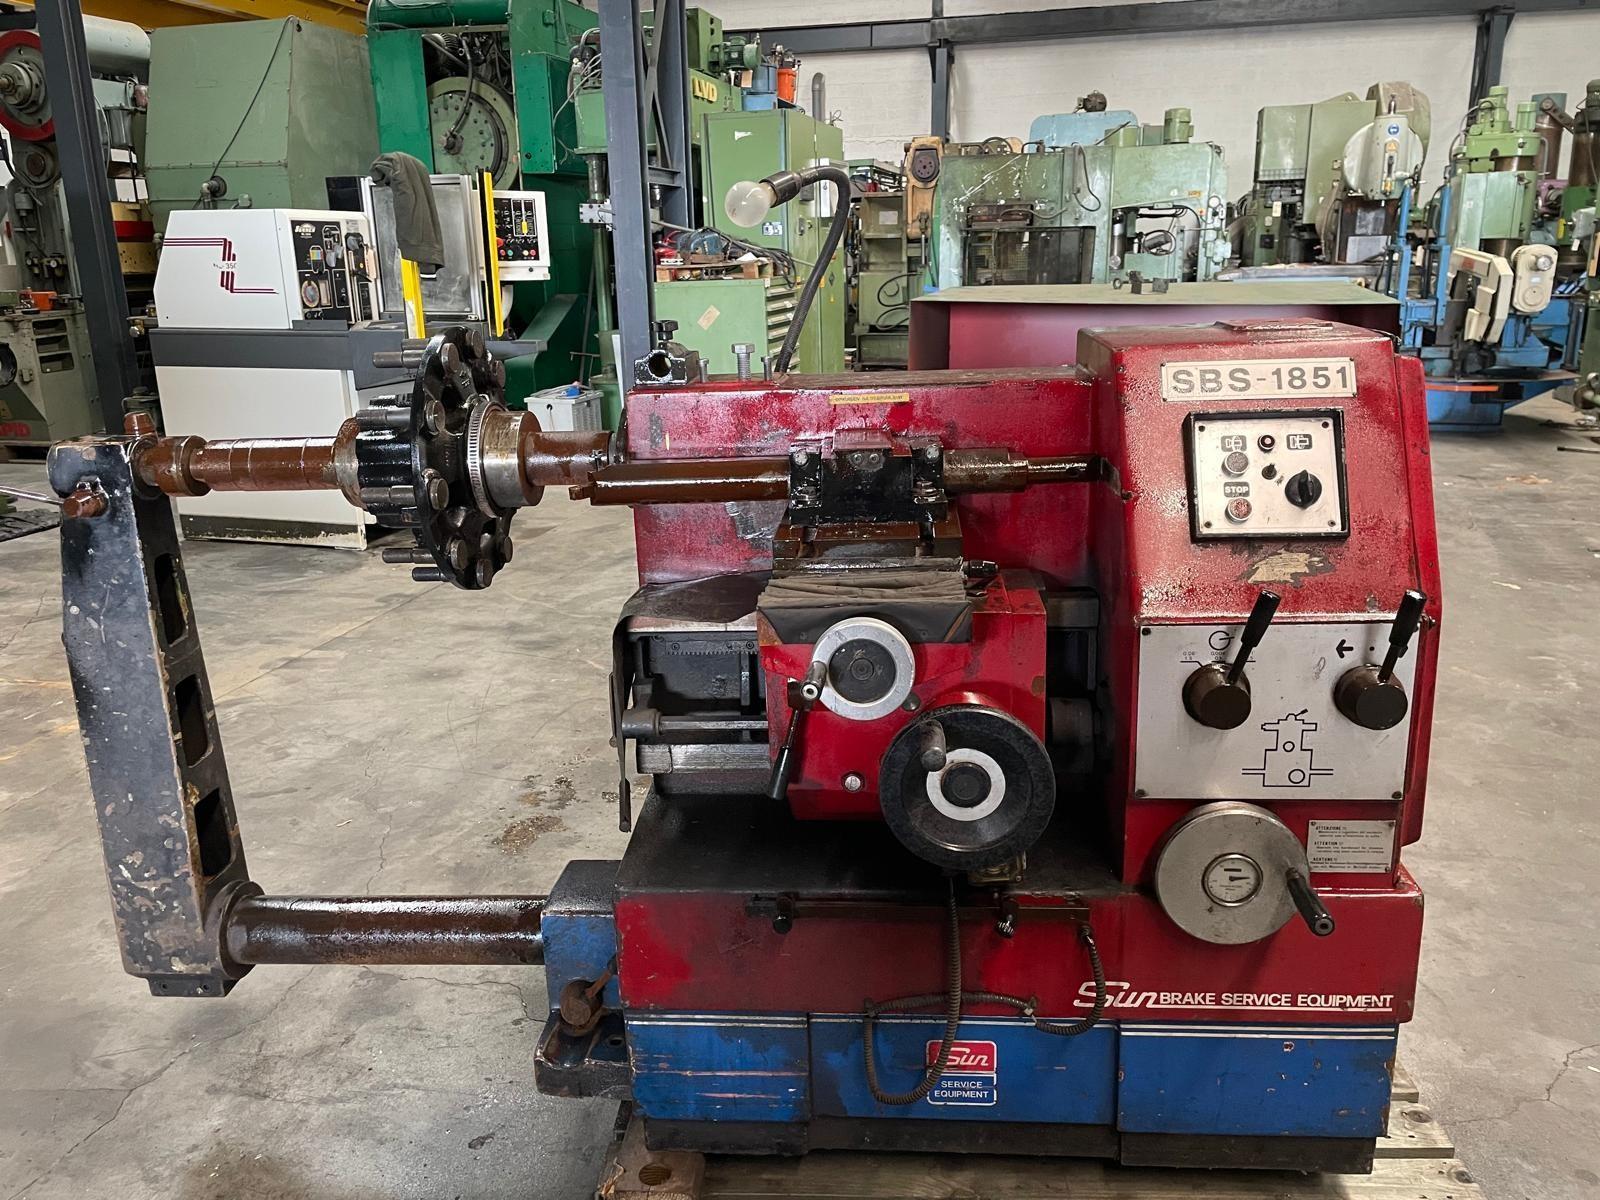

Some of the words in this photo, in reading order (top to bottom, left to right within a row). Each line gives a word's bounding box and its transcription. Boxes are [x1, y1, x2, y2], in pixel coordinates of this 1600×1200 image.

[694, 79, 718, 101] LVD
[1172, 366, 1348, 393] SBS-1851
[1224, 485, 1249, 494] STOP
[1073, 982, 1157, 1008] Sun
[1160, 992, 1216, 1006] BRAKE
[1221, 992, 1291, 1007] SERVICE
[1297, 994, 1394, 1008] EQUIPMENT
[935, 1047, 989, 1066] Sun
[934, 1090, 989, 1099] EQUIPMENT
[941, 1081, 982, 1089] SERVICE
